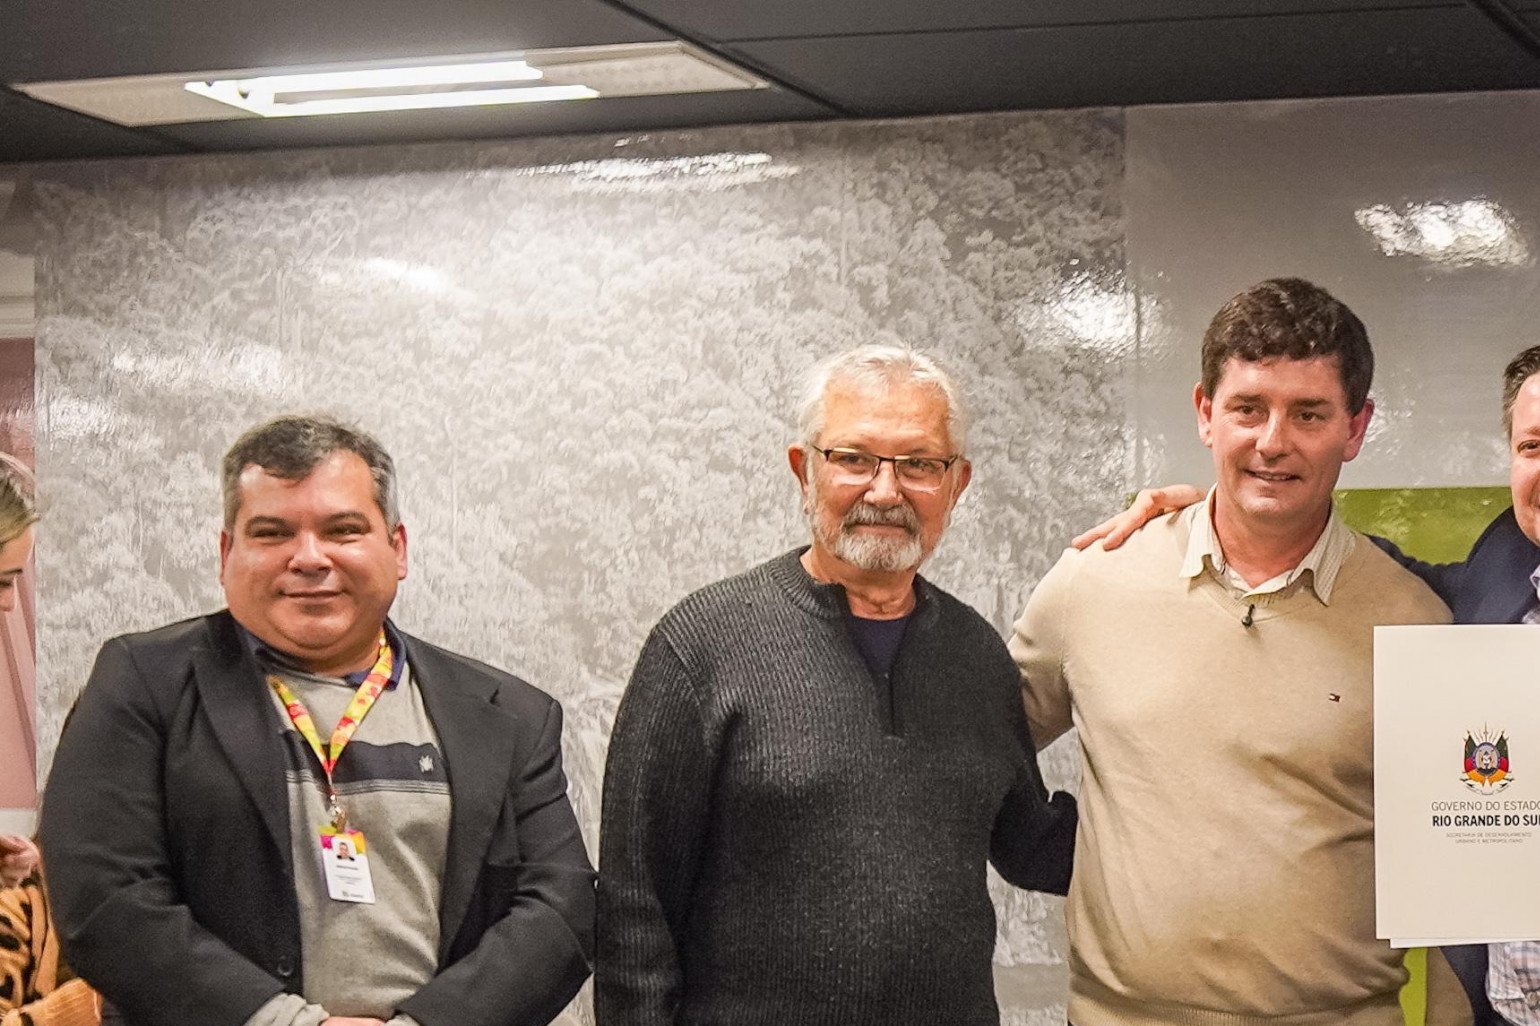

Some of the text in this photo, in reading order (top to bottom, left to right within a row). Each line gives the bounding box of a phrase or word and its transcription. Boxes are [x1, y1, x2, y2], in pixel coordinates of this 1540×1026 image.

[1431, 801, 1482, 811] GOVERNO
[1485, 801, 1501, 811] DO
[1432, 815, 1452, 827] RIO
[1454, 815, 1501, 827] GRANDE
[1504, 814, 1520, 826] DO
